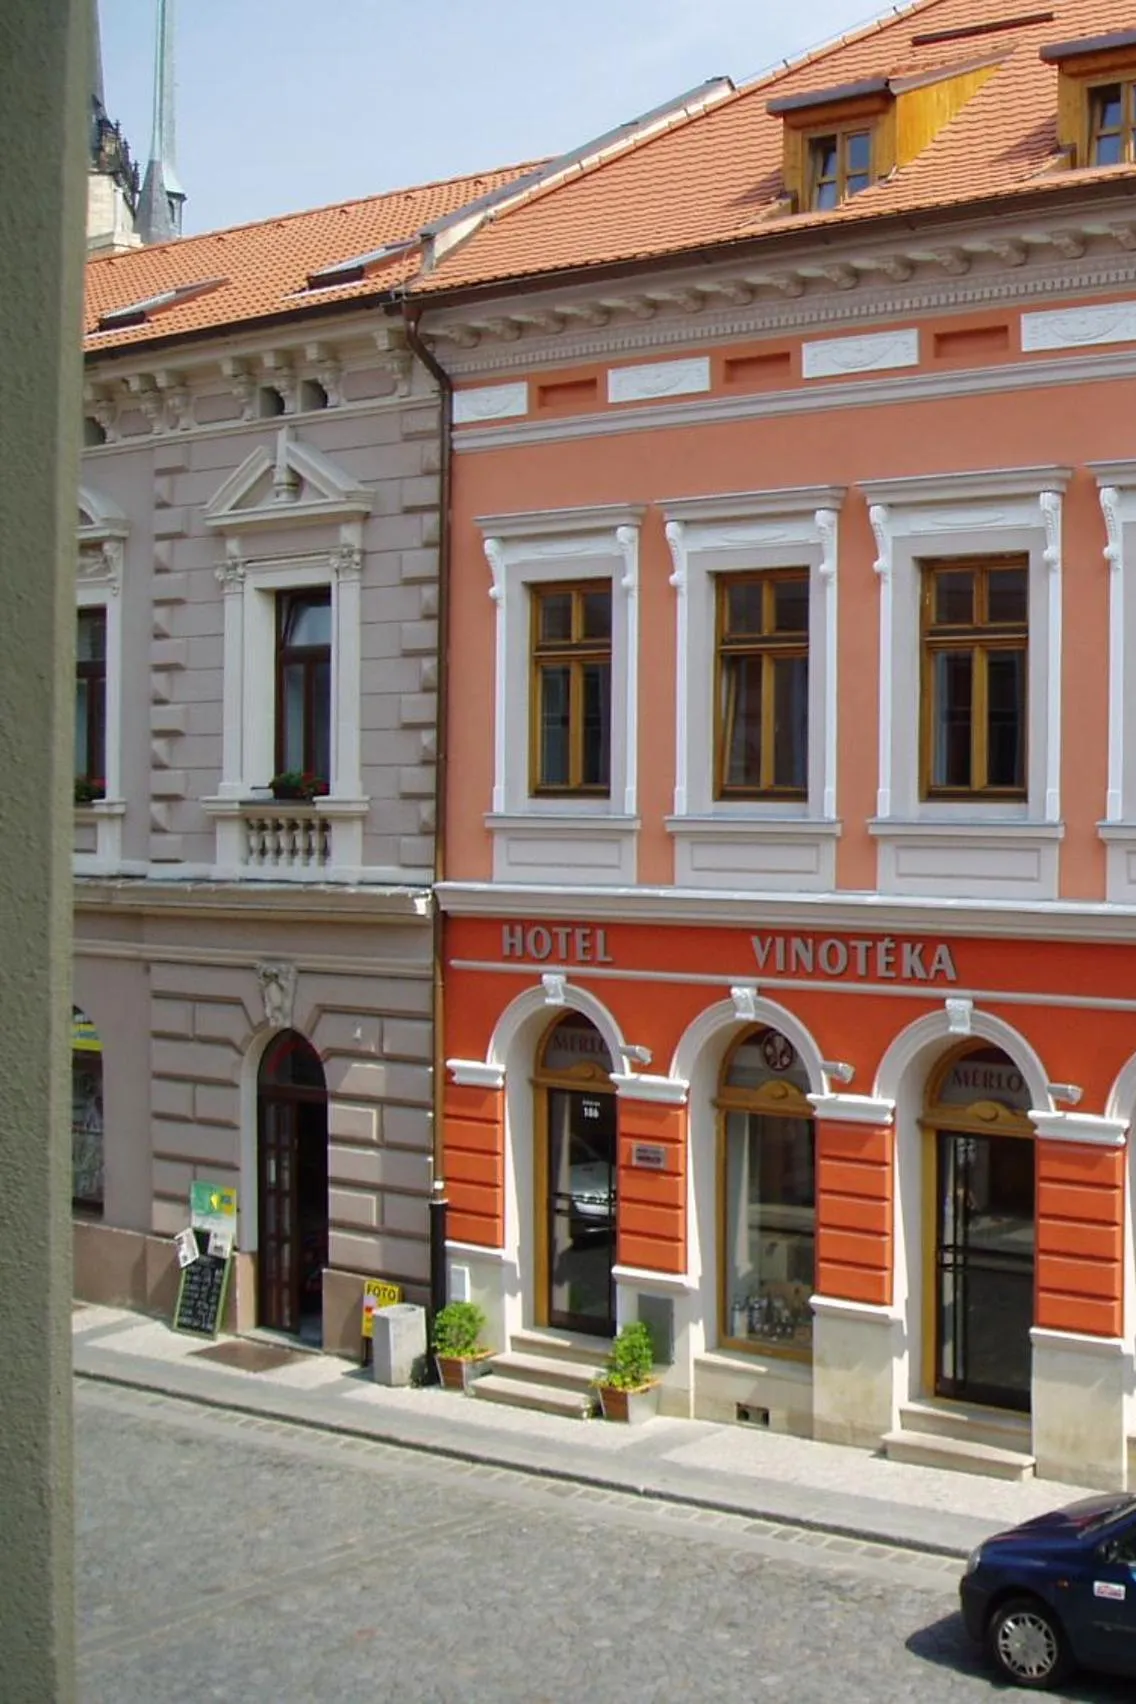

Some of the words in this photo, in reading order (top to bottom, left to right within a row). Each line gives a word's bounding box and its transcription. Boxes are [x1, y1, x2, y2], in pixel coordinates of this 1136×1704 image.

[502, 924, 613, 962] HOTEL
[751, 935, 956, 981] VINOTÉKA
[366, 1283, 396, 1301] FOTO
